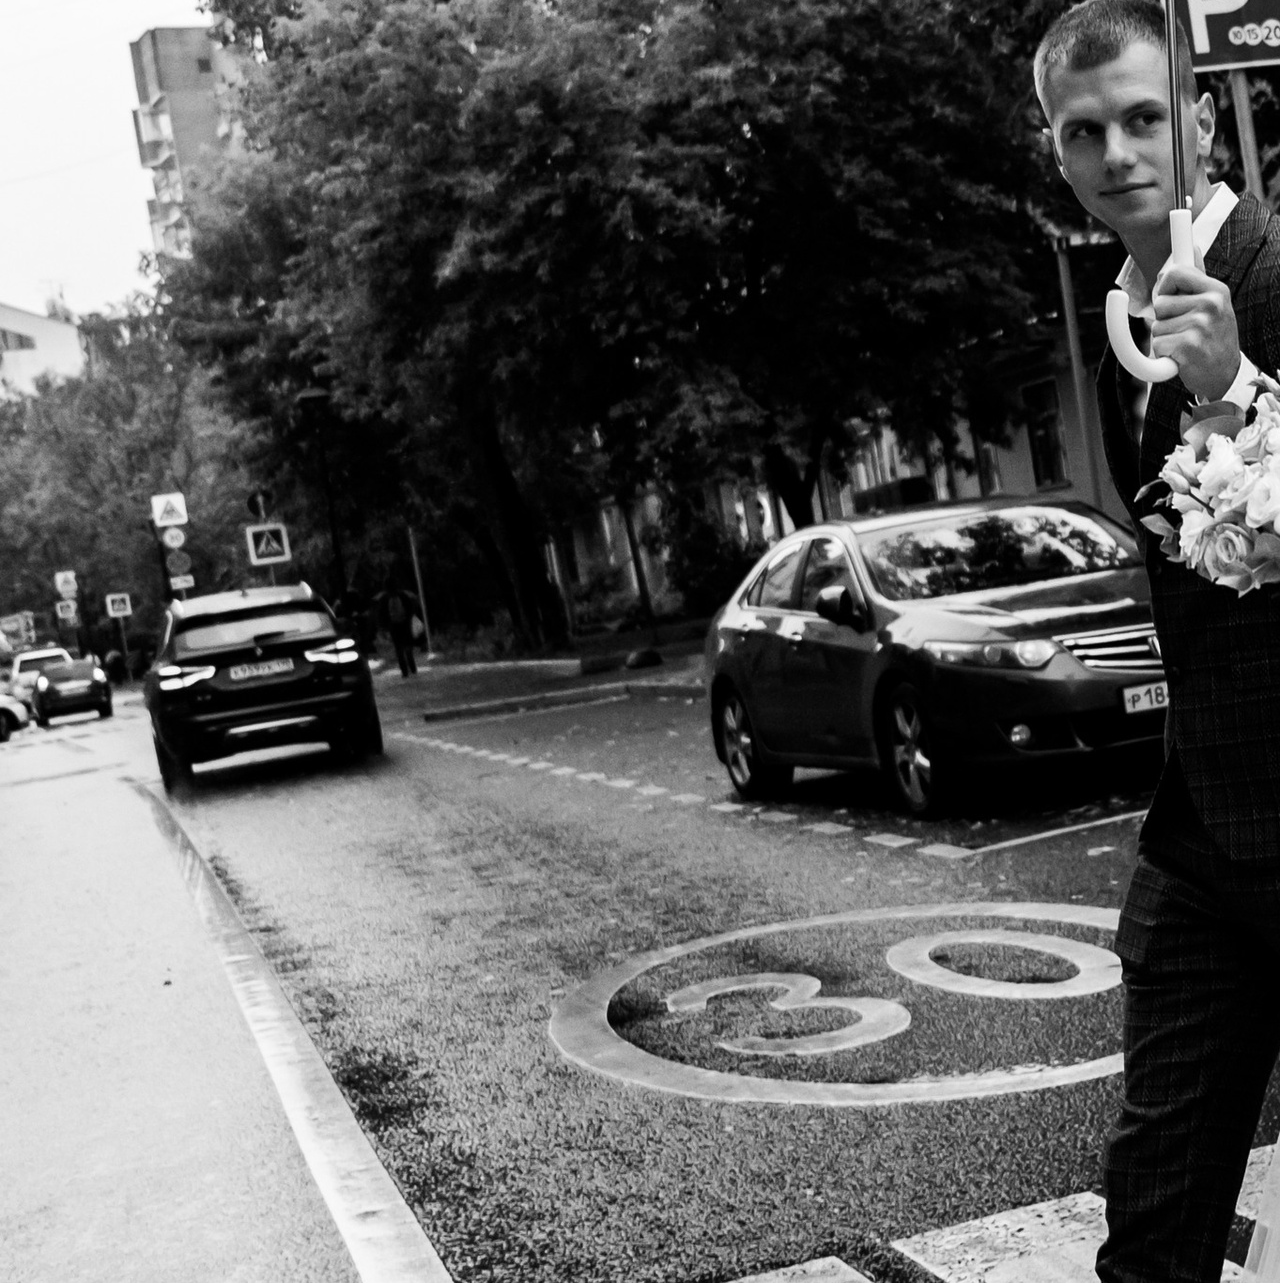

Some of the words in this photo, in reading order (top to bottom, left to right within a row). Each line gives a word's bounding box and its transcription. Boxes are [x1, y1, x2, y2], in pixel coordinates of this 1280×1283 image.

[1246, 28, 1259, 40] 15
[1131, 684, 1168, 709] Р18
[660, 928, 1123, 1056] 30
